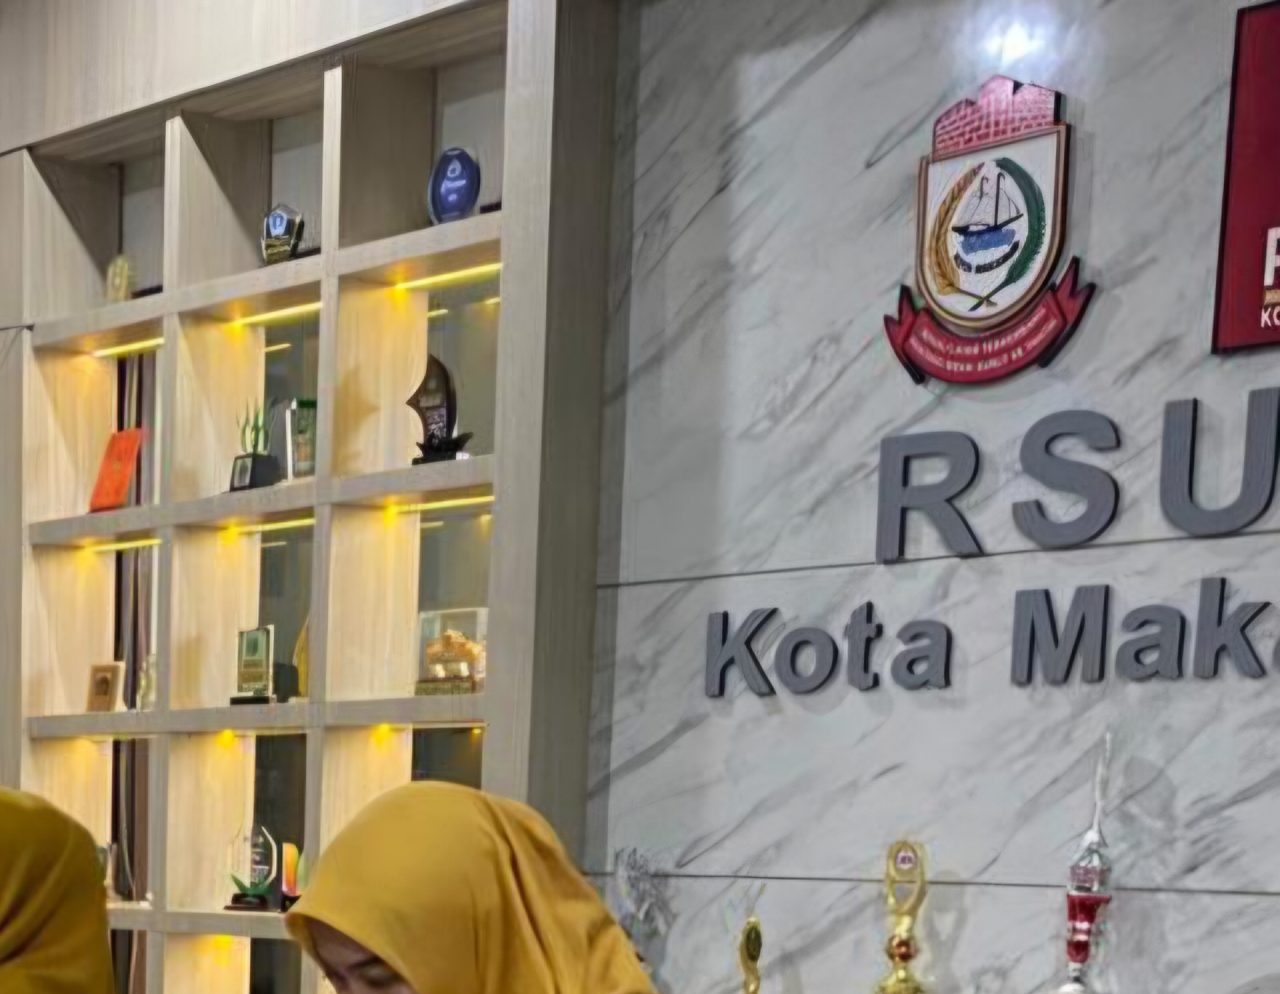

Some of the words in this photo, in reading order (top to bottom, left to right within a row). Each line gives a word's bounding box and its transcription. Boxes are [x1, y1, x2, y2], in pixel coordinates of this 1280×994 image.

[876, 386, 1280, 564] RSU
[705, 601, 952, 698] Kota
[1010, 577, 1280, 686] Mak
